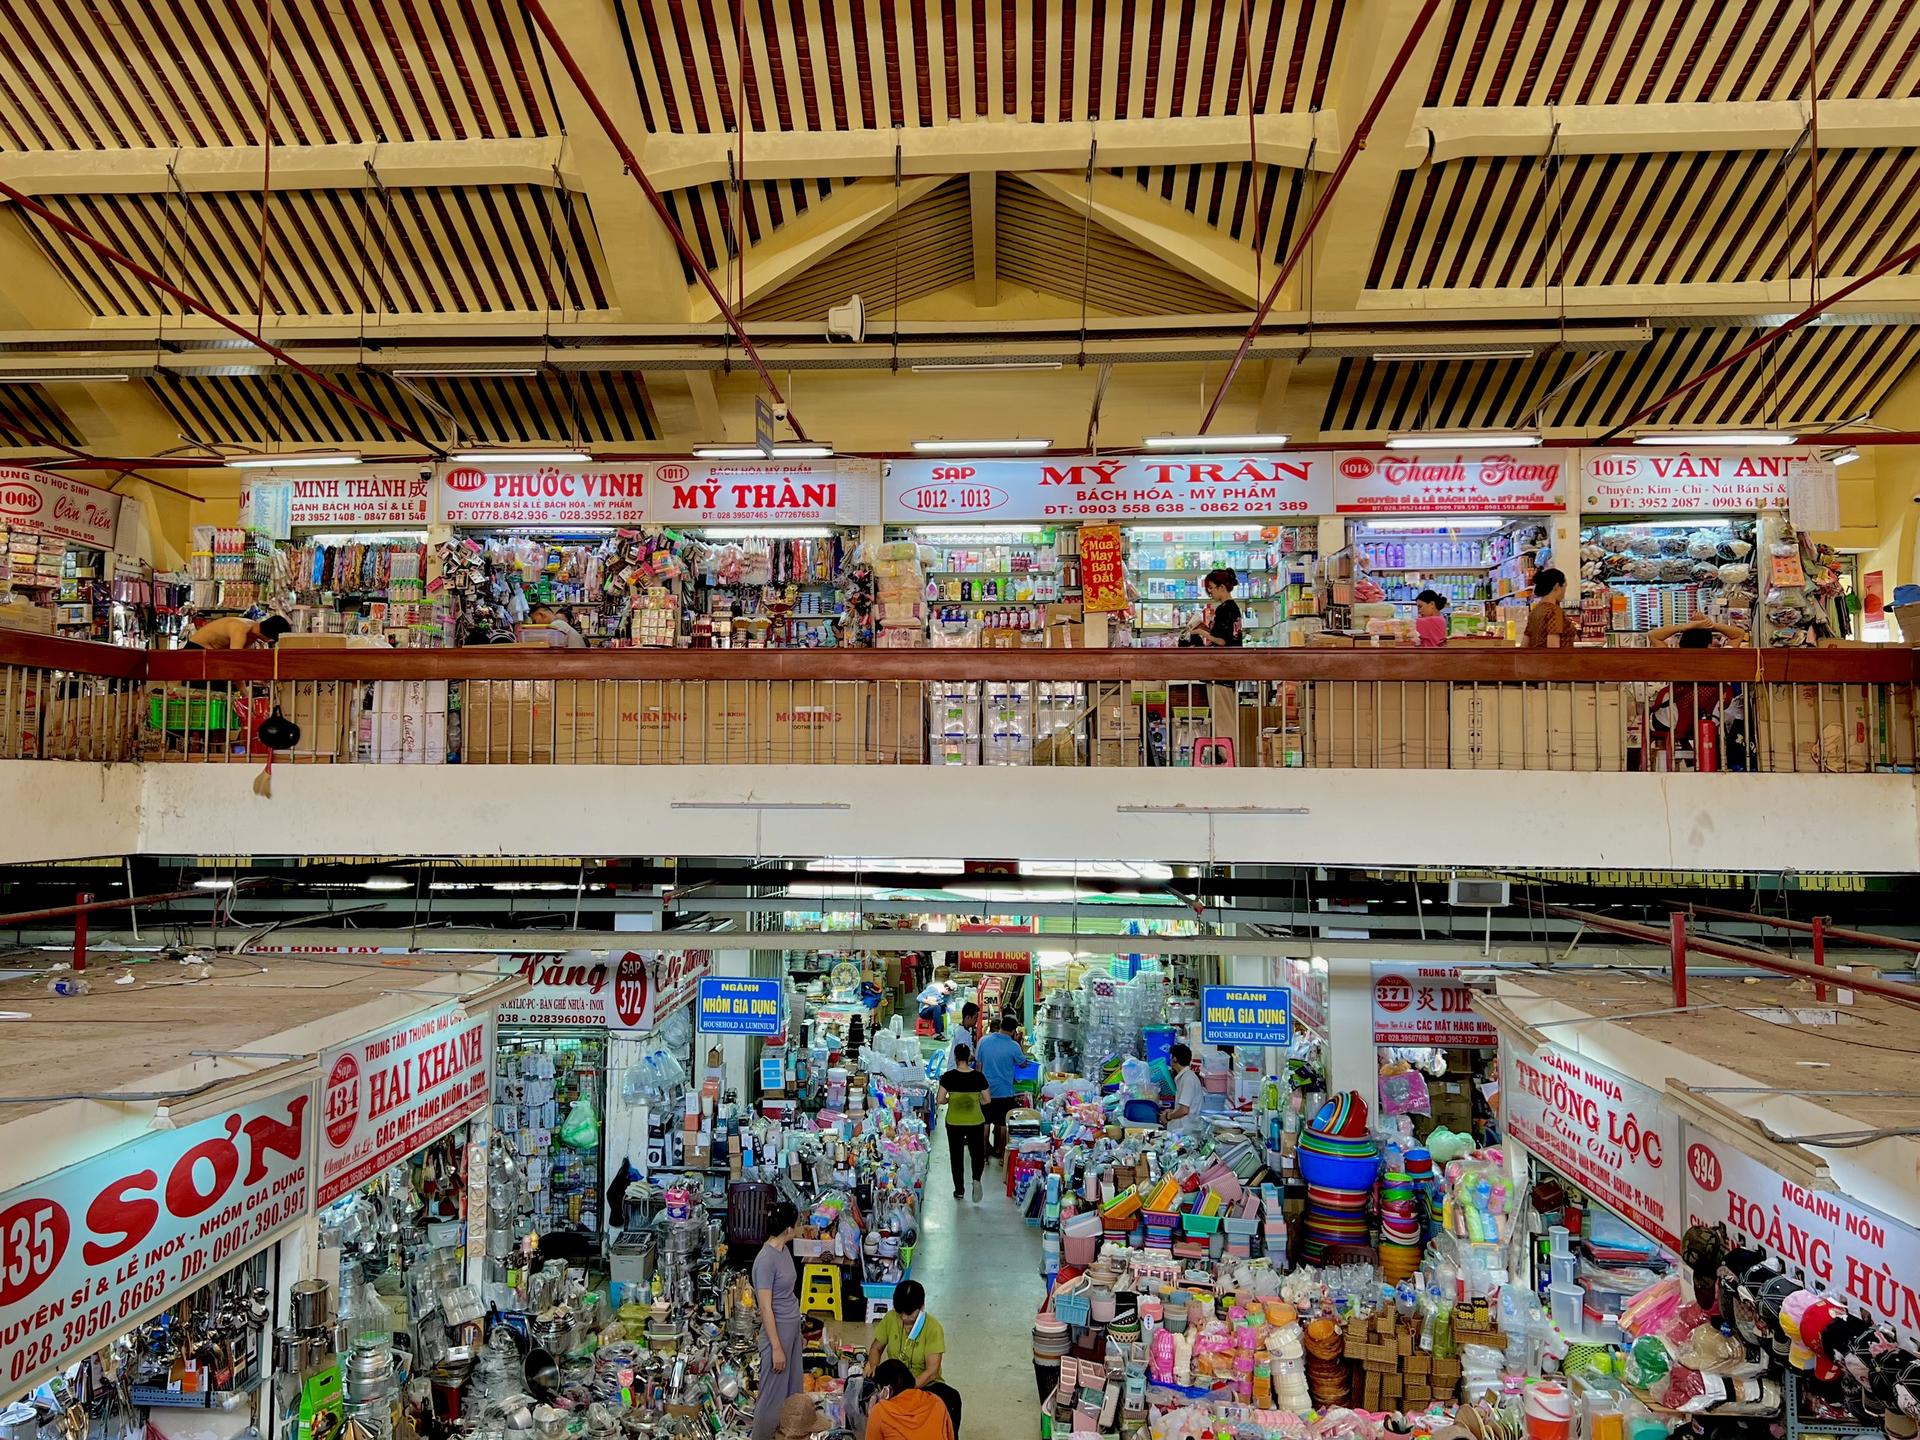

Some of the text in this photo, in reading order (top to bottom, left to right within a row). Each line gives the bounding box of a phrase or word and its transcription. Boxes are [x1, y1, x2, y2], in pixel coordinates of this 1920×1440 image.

[662, 468, 684, 480] 1011
[1038, 458, 1314, 486] MỸ TRÂN
[1342, 463, 1370, 474] 1014
[1377, 455, 1561, 492] Thanh Giang
[1592, 459, 1637, 476] 1015
[1650, 452, 1721, 478] VÂN
[453, 472, 482, 488] 1010
[493, 467, 644, 498] PHƯỚC VINH
[931, 467, 976, 483] SẠP
[70, 484, 90, 497] SINH
[293, 475, 406, 498] MINH THÀNH
[672, 478, 722, 509] MỸ
[1076, 482, 1276, 501] BÁCH HÓA MỸ PHẨM
[1597, 484, 1644, 496] Chuyên:
[1648, 484, 1672, 494] Kim
[1712, 483, 1734, 494] Nút
[917, 488, 991, 509] 1012 1013
[1610, 497, 1742, 509] ĐT: 3952 2087 0903
[308, 513, 330, 522] 3952
[333, 513, 355, 521] 1408
[364, 512, 387, 521] 0847
[408, 512, 426, 521] 546
[447, 510, 644, 520] ĐT: 0778.842.936 028.3952.1827
[702, 512, 715, 520] ĐT:
[717, 512, 731, 520] 028
[732, 512, 768, 520] 39507465
[1044, 502, 1308, 514] ĐT: 0903 558 638 0862 021 389
[1089, 540, 1114, 550] Mua
[1090, 551, 1114, 564] May
[622, 960, 642, 977] SẠP
[984, 962, 1018, 970] SMOKING
[1418, 968, 1446, 977] TRUNG
[721, 982, 760, 992] NGÀNH
[1226, 990, 1267, 1002] NGÀNH
[1377, 988, 1409, 1000] 371
[589, 1000, 604, 1010] INOX
[620, 980, 641, 1015] 372
[983, 996, 998, 1005] 3M
[1416, 986, 1438, 1012] 炎
[703, 996, 776, 1020] NHÔM GIA DỤNG
[498, 1014, 606, 1024] 038 02839608070
[703, 1020, 738, 1030] HOUSEHOLD
[746, 1022, 776, 1030] LUMINIUM
[1207, 1005, 1286, 1030] NHỰA GIA DỤNG
[1208, 1030, 1286, 1042] HOUSEHOLD PLASTIS
[365, 1041, 390, 1062] TRUNG
[368, 1058, 412, 1120] HAI
[417, 1024, 484, 1095] KHANH
[1584, 1072, 1623, 1102] NHỰA
[324, 1080, 358, 1122] 434
[1516, 1059, 1600, 1135] TRƯỜNG
[1608, 1110, 1662, 1168] LỘC
[376, 1120, 396, 1148] CÁC
[1693, 1148, 1716, 1188] 394
[82, 1094, 308, 1266] SƠN
[1782, 1180, 1885, 1249] NGÀNH NÓN
[72, 1278, 91, 1310] SỈ
[116, 1254, 138, 1286] LẺ
[144, 1233, 186, 1268] INOX
[200, 1204, 243, 1240] NHÔM
[246, 1189, 269, 1211] GIA
[272, 1166, 306, 1198] DỤNG
[1726, 1189, 1833, 1282] HOÀNG
[0, 1206, 54, 1294] 35
[10, 1269, 166, 1382] 028.3950.8663
[212, 1186, 306, 1264] 0907.390.997
